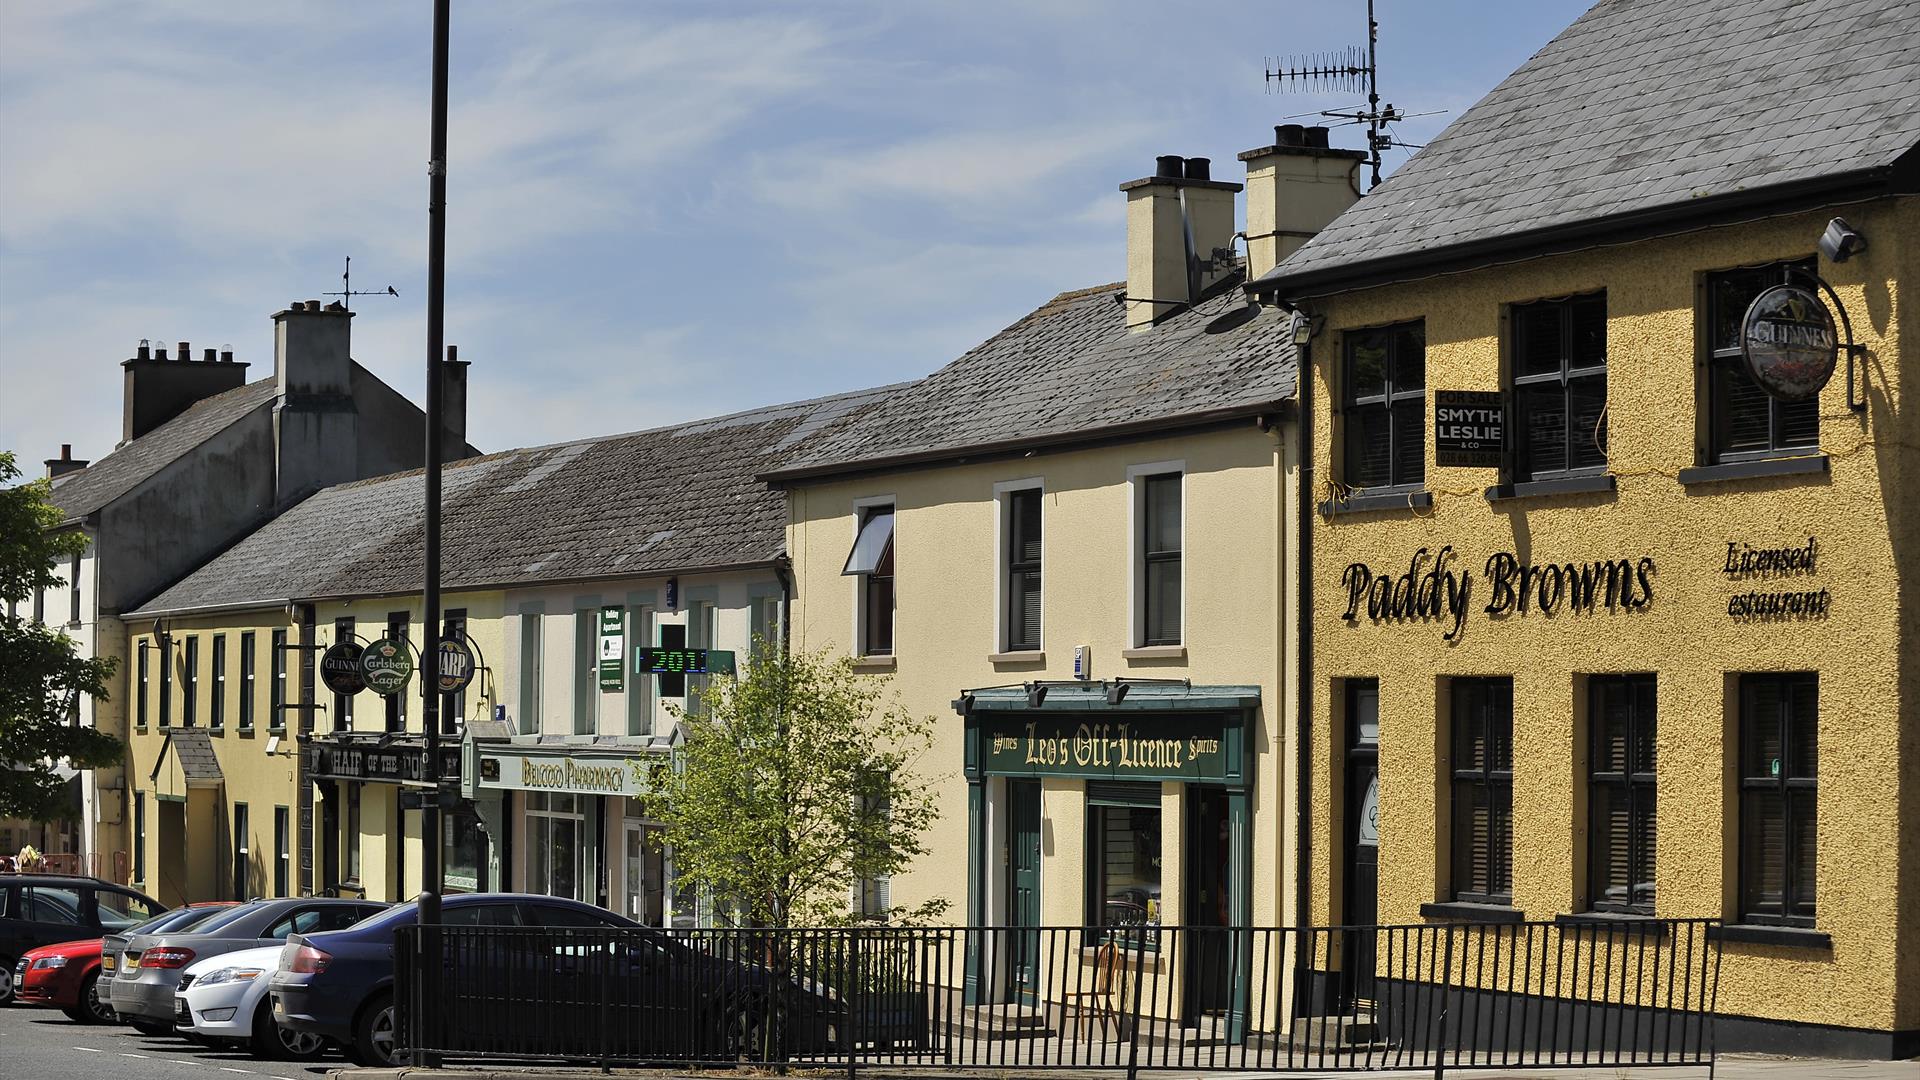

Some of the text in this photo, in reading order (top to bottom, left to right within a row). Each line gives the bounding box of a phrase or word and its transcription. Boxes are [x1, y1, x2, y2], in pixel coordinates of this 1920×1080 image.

[1755, 320, 1833, 349] GUINNESS
[1438, 408, 1502, 423] SMYTH
[1439, 425, 1501, 440] LESLIE
[1723, 536, 1815, 573] Licensed
[1342, 546, 1653, 640] Paddy Browns
[325, 657, 360, 672] GUINN
[364, 655, 410, 674] Carlsberg
[371, 674, 404, 688] Lager
[993, 721, 1218, 768] Wines Leo's Off-Licence Spirits
[368, 754, 379, 772] OF
[381, 755, 398, 773] THE
[522, 756, 625, 792] BELCOO PHARMACY
